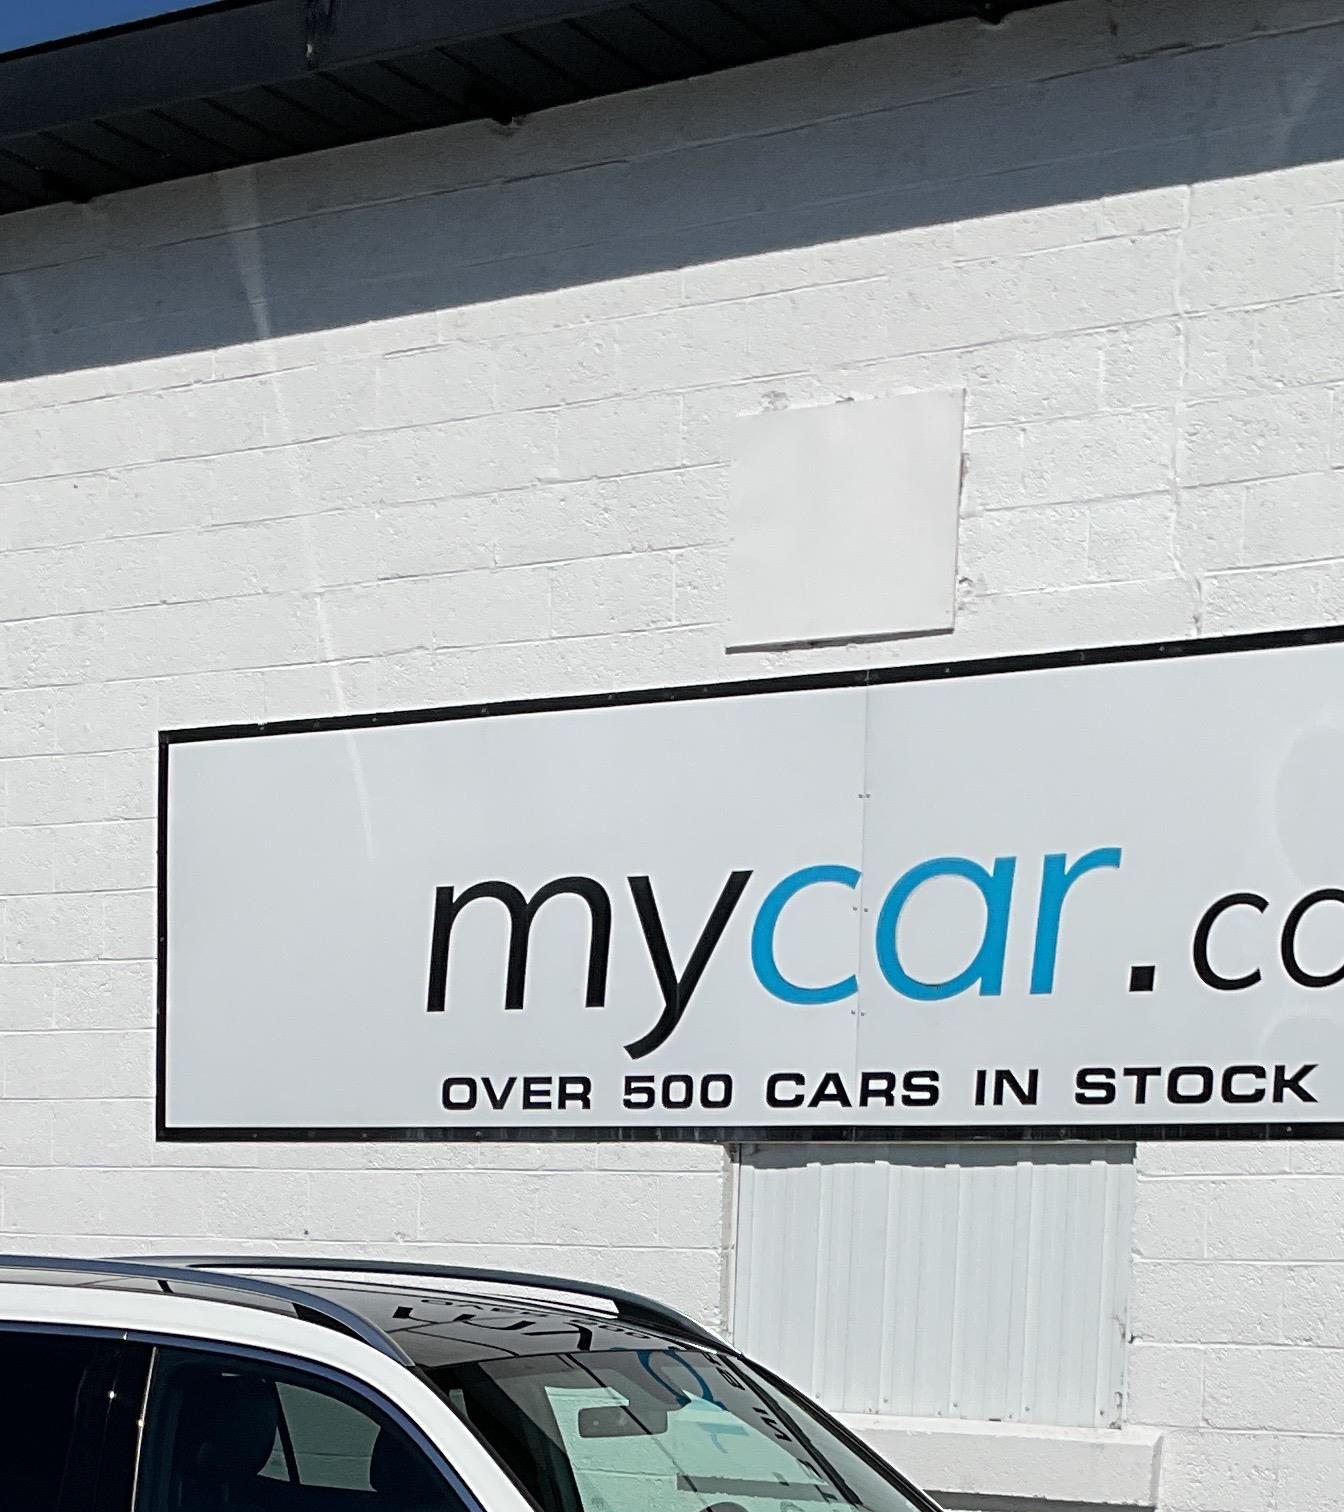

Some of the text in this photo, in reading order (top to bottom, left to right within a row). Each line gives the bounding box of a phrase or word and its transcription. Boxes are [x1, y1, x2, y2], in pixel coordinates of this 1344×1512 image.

[442, 1064, 1318, 1111] OVER 500 CARS IN STOCK
